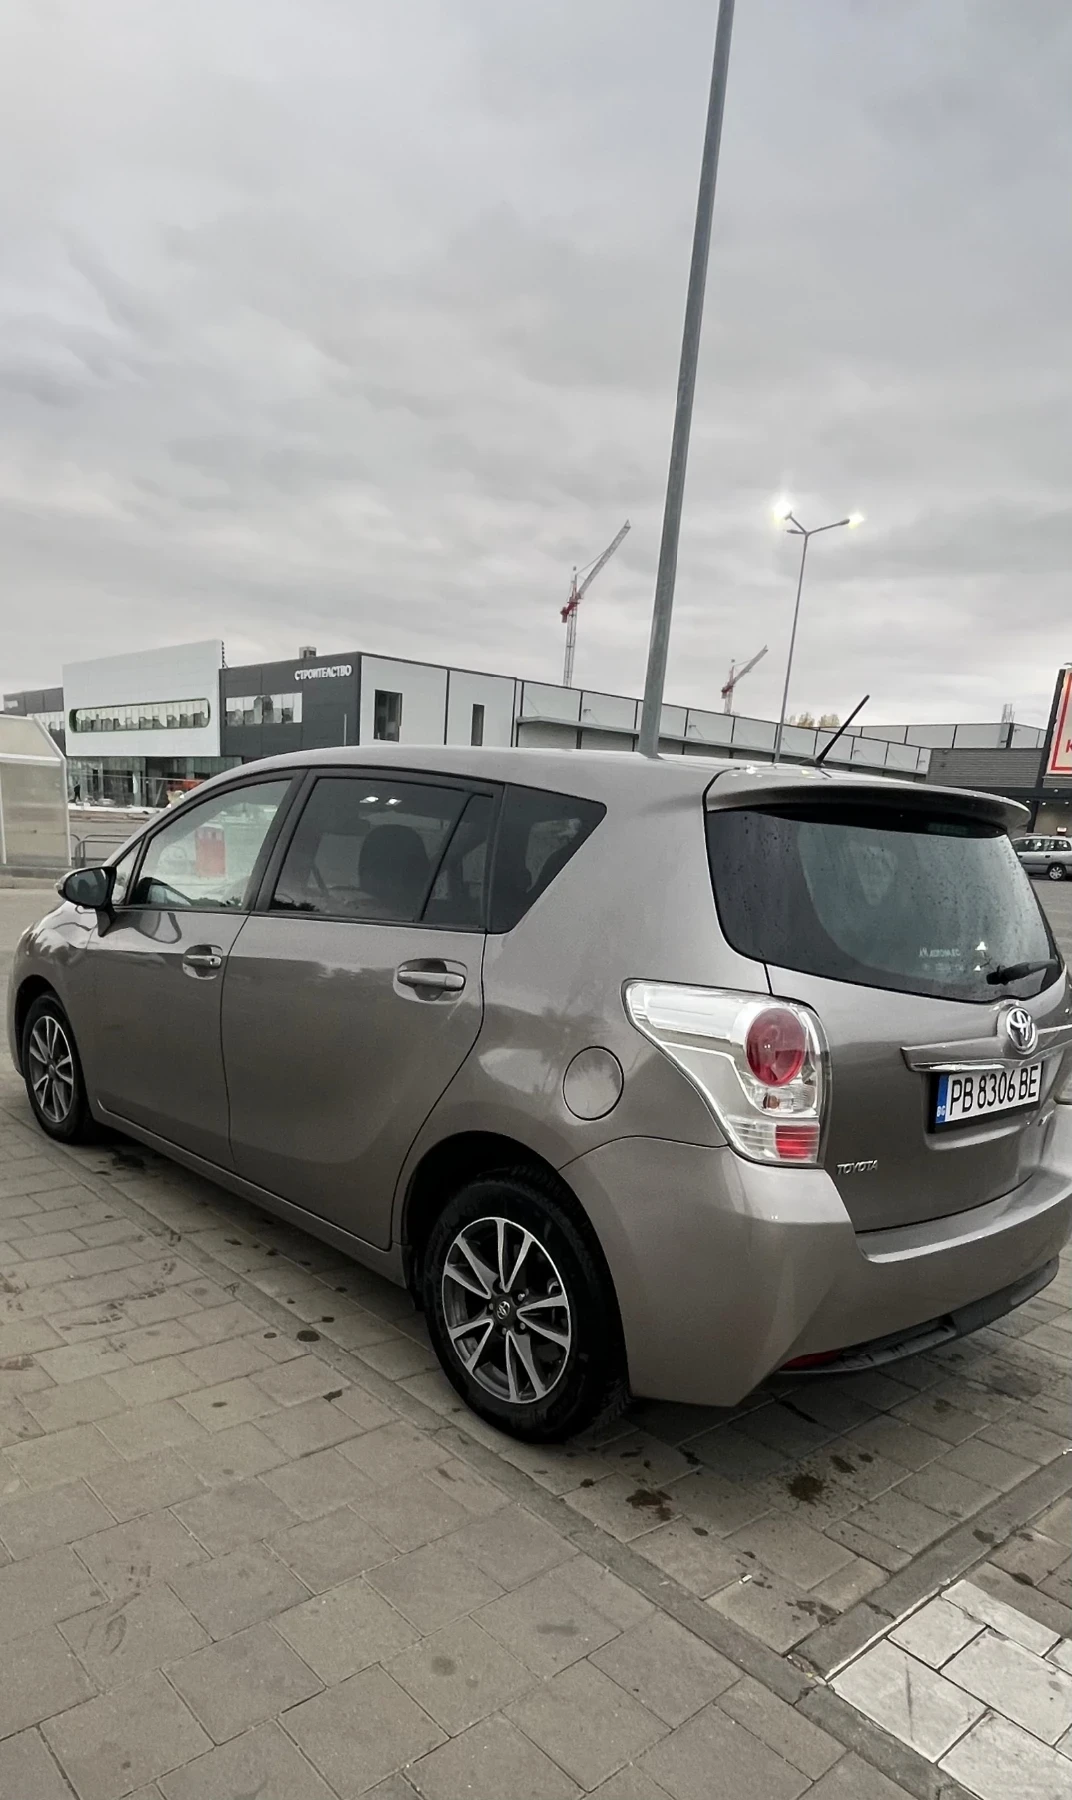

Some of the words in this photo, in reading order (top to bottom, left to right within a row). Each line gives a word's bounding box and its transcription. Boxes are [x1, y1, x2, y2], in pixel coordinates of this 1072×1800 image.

[294, 664, 353, 680] СТРОИТЕЛСТВО
[950, 1077, 974, 1116] PB
[977, 1069, 1016, 1109] 8306
[1018, 1065, 1039, 1101] BE
[936, 1105, 946, 1117] BG
[837, 1160, 878, 1174] TOYOTA
